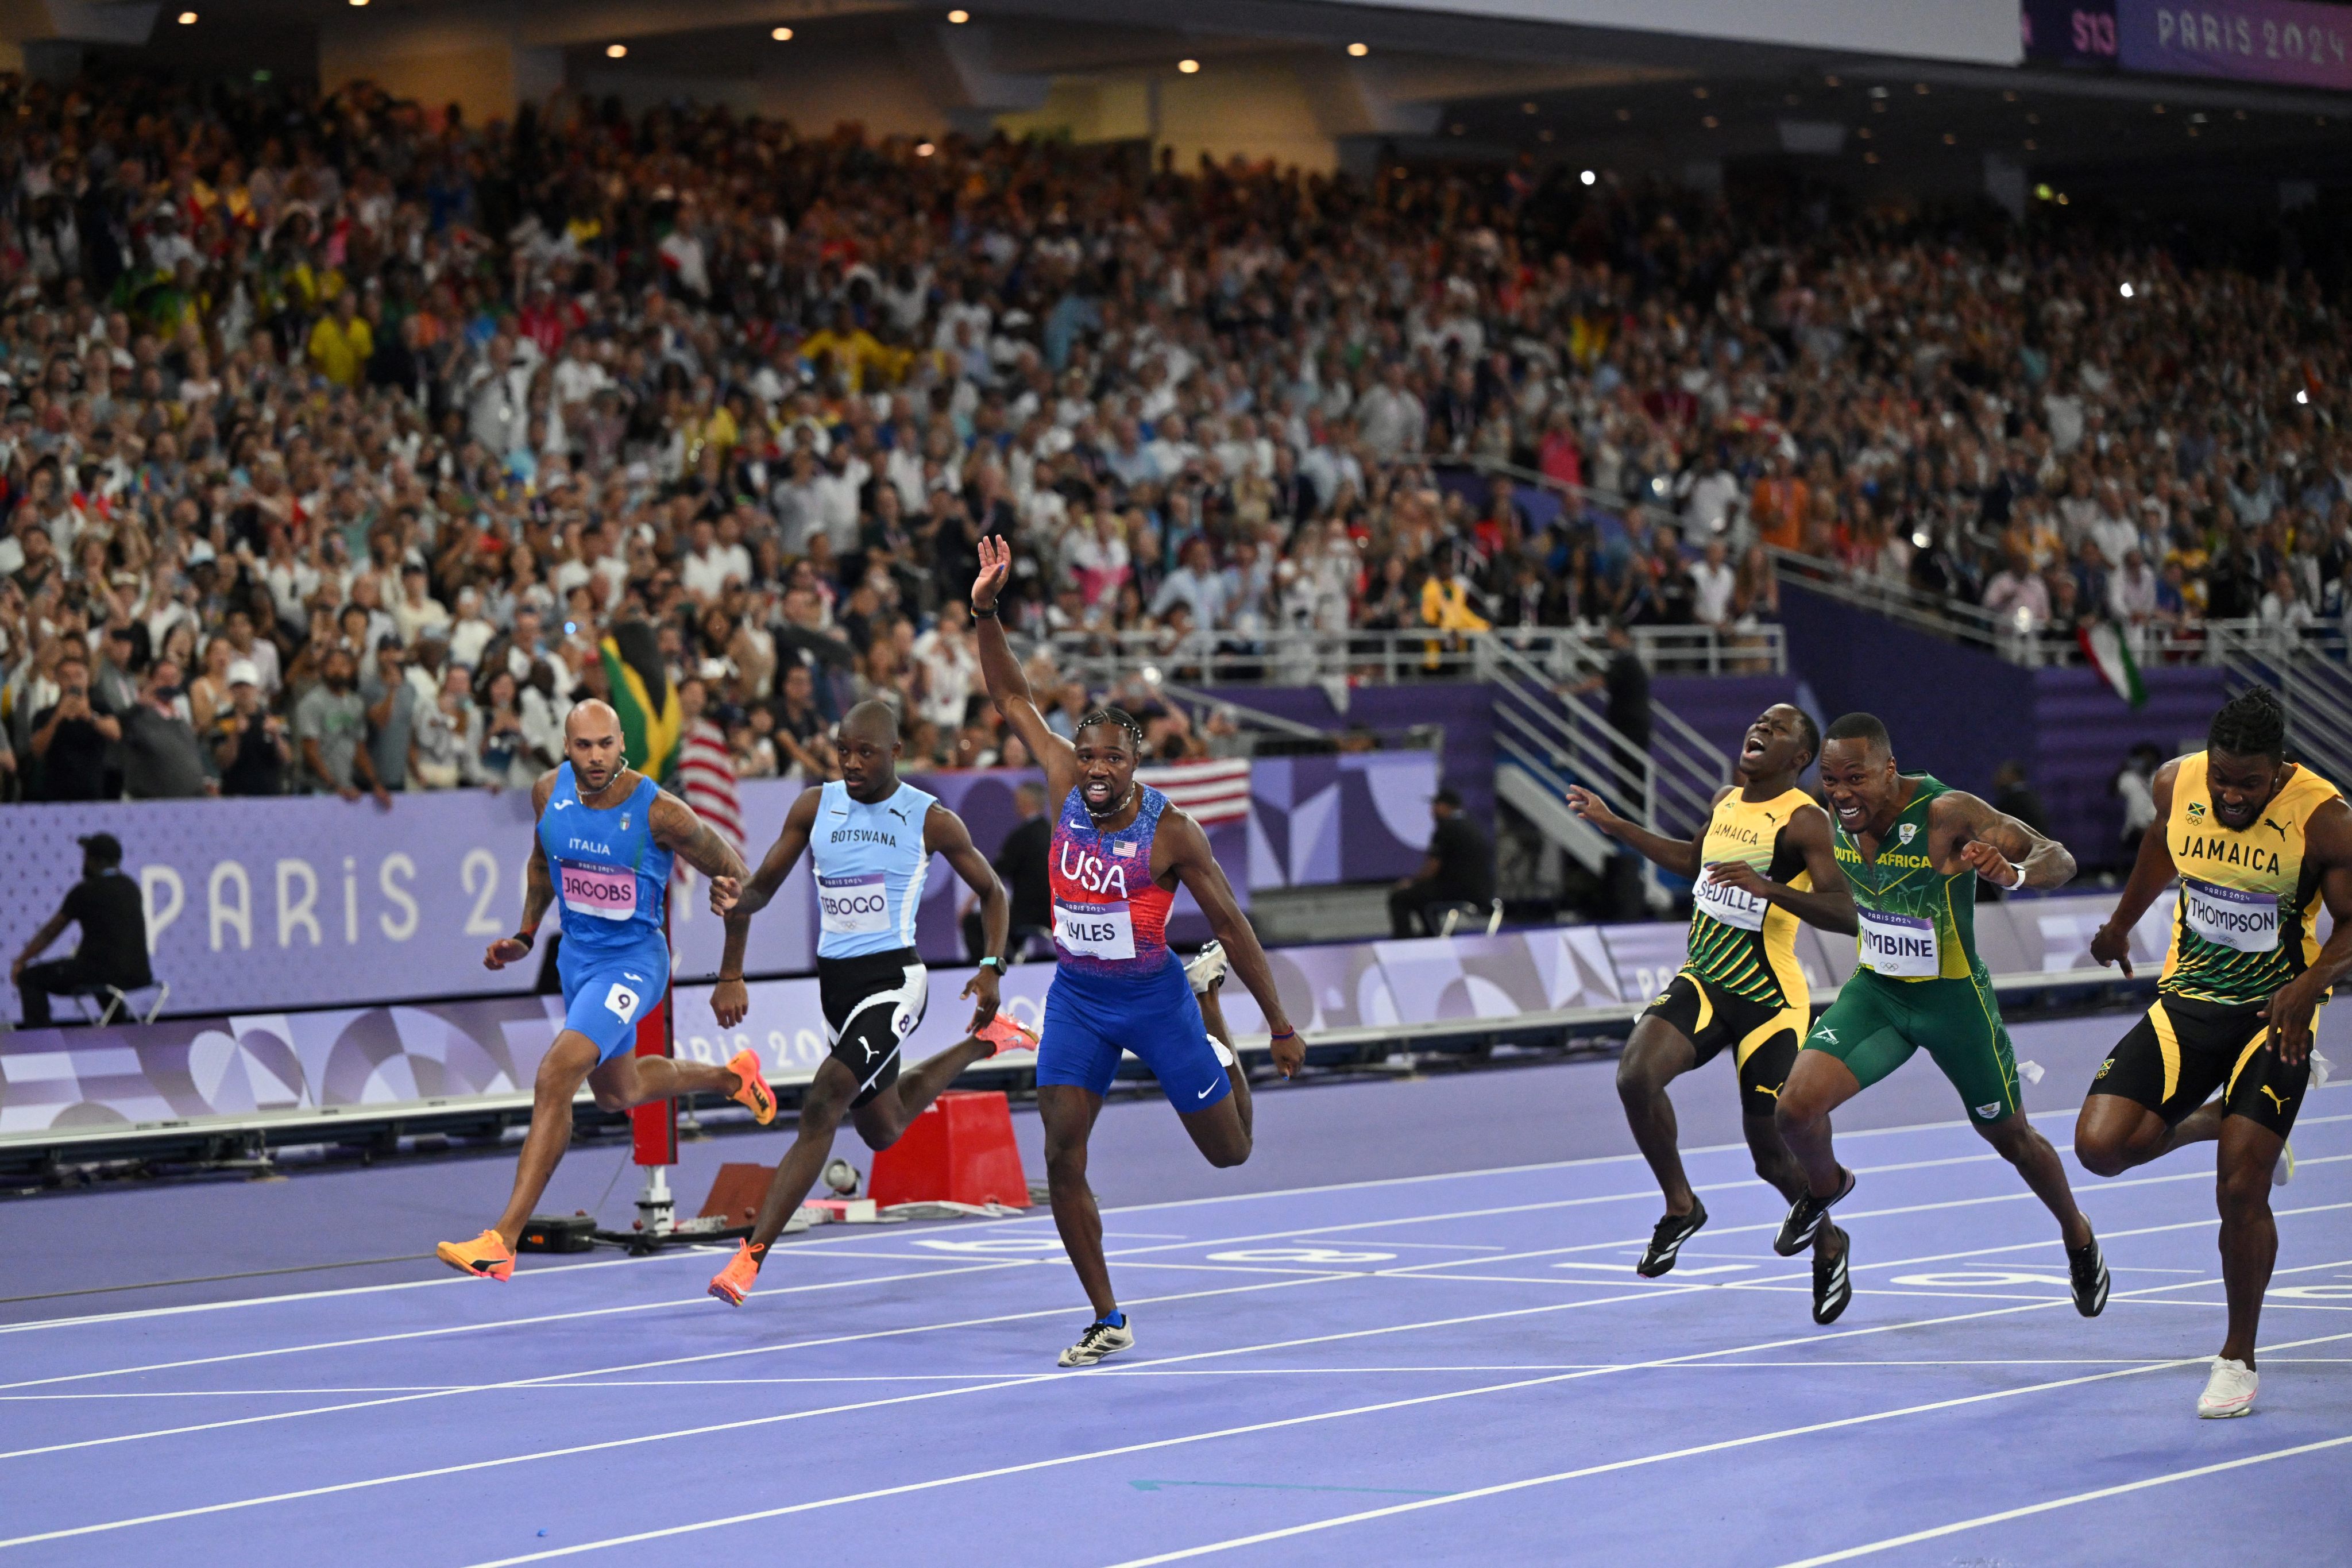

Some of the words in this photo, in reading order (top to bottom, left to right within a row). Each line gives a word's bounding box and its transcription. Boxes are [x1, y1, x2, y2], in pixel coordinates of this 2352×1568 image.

[2157, 8, 2253, 56] PARIS
[2263, 19, 2346, 64] 2024
[831, 829, 896, 848] BOTSWANA
[1710, 823, 1758, 845] JAMAICA
[569, 838, 611, 856] ITALIA
[1834, 845, 1862, 864] OUTH
[1876, 853, 1933, 868] AFRICA
[2179, 836, 2279, 876] JAMAICA
[1061, 840, 1127, 898] USA
[564, 876, 631, 901] JACOBS
[2229, 893, 2250, 901] 2024
[821, 895, 885, 915] TEBOGO
[2191, 897, 2274, 933] THOMPSON
[1066, 919, 1115, 941] LYLES
[1891, 916, 1911, 924] 2024
[1861, 925, 1933, 957] SIMBINE
[618, 994, 631, 1010] 9
[899, 1014, 909, 1033] 8
